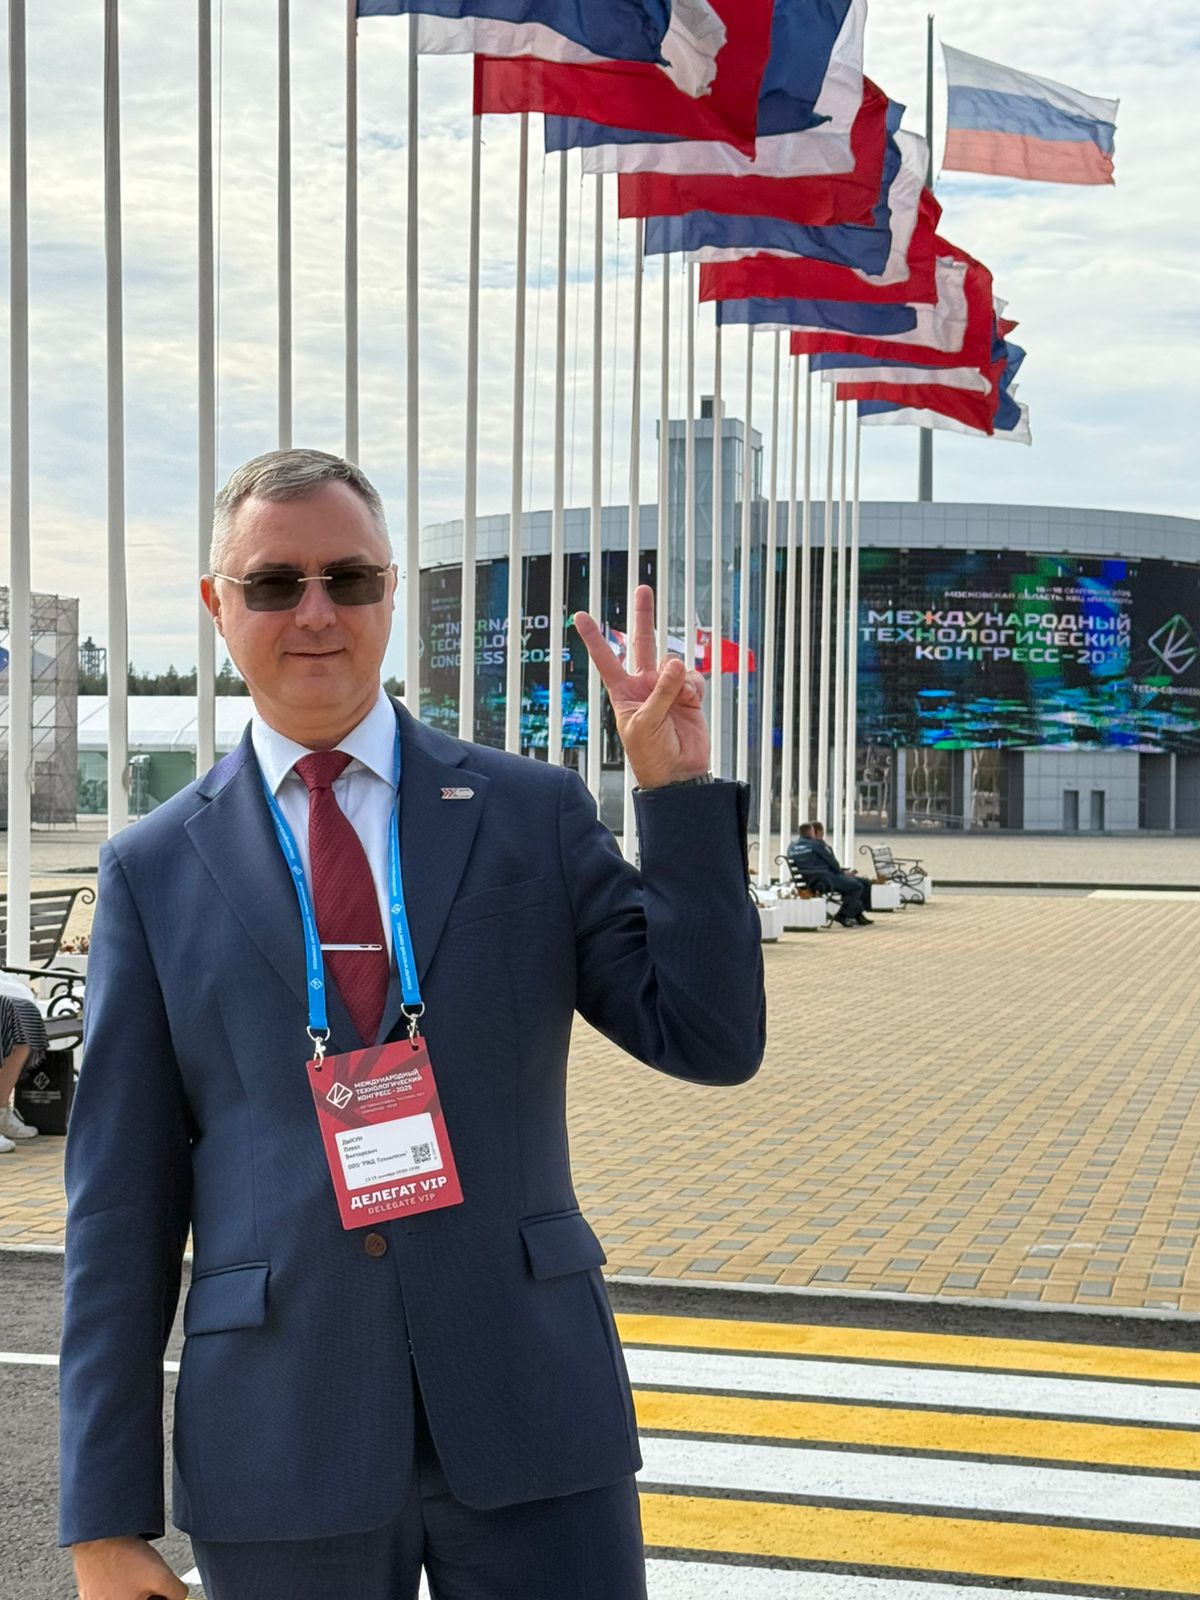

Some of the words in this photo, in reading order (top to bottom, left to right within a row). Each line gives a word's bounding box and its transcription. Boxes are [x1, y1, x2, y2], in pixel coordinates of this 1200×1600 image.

[868, 610, 1131, 630] МЕЖДУНАРОДНЫЙ
[430, 632, 531, 653] TECHOLOY
[859, 627, 1131, 648] ТЕХНОЛОГИЧЕСКИЙ
[430, 650, 505, 669] CONGESS
[354, 1068, 420, 1088] МЕЖДУНАРОДНЫЙ
[355, 1075, 423, 1095] ТЕХНОЛОГИЧЕСКИЙ
[350, 1183, 417, 1210] ДЕЛЕГАТ
[420, 1176, 448, 1191] VIP
[368, 1198, 416, 1215] DELEGATE
[418, 1193, 436, 1203] VIP
